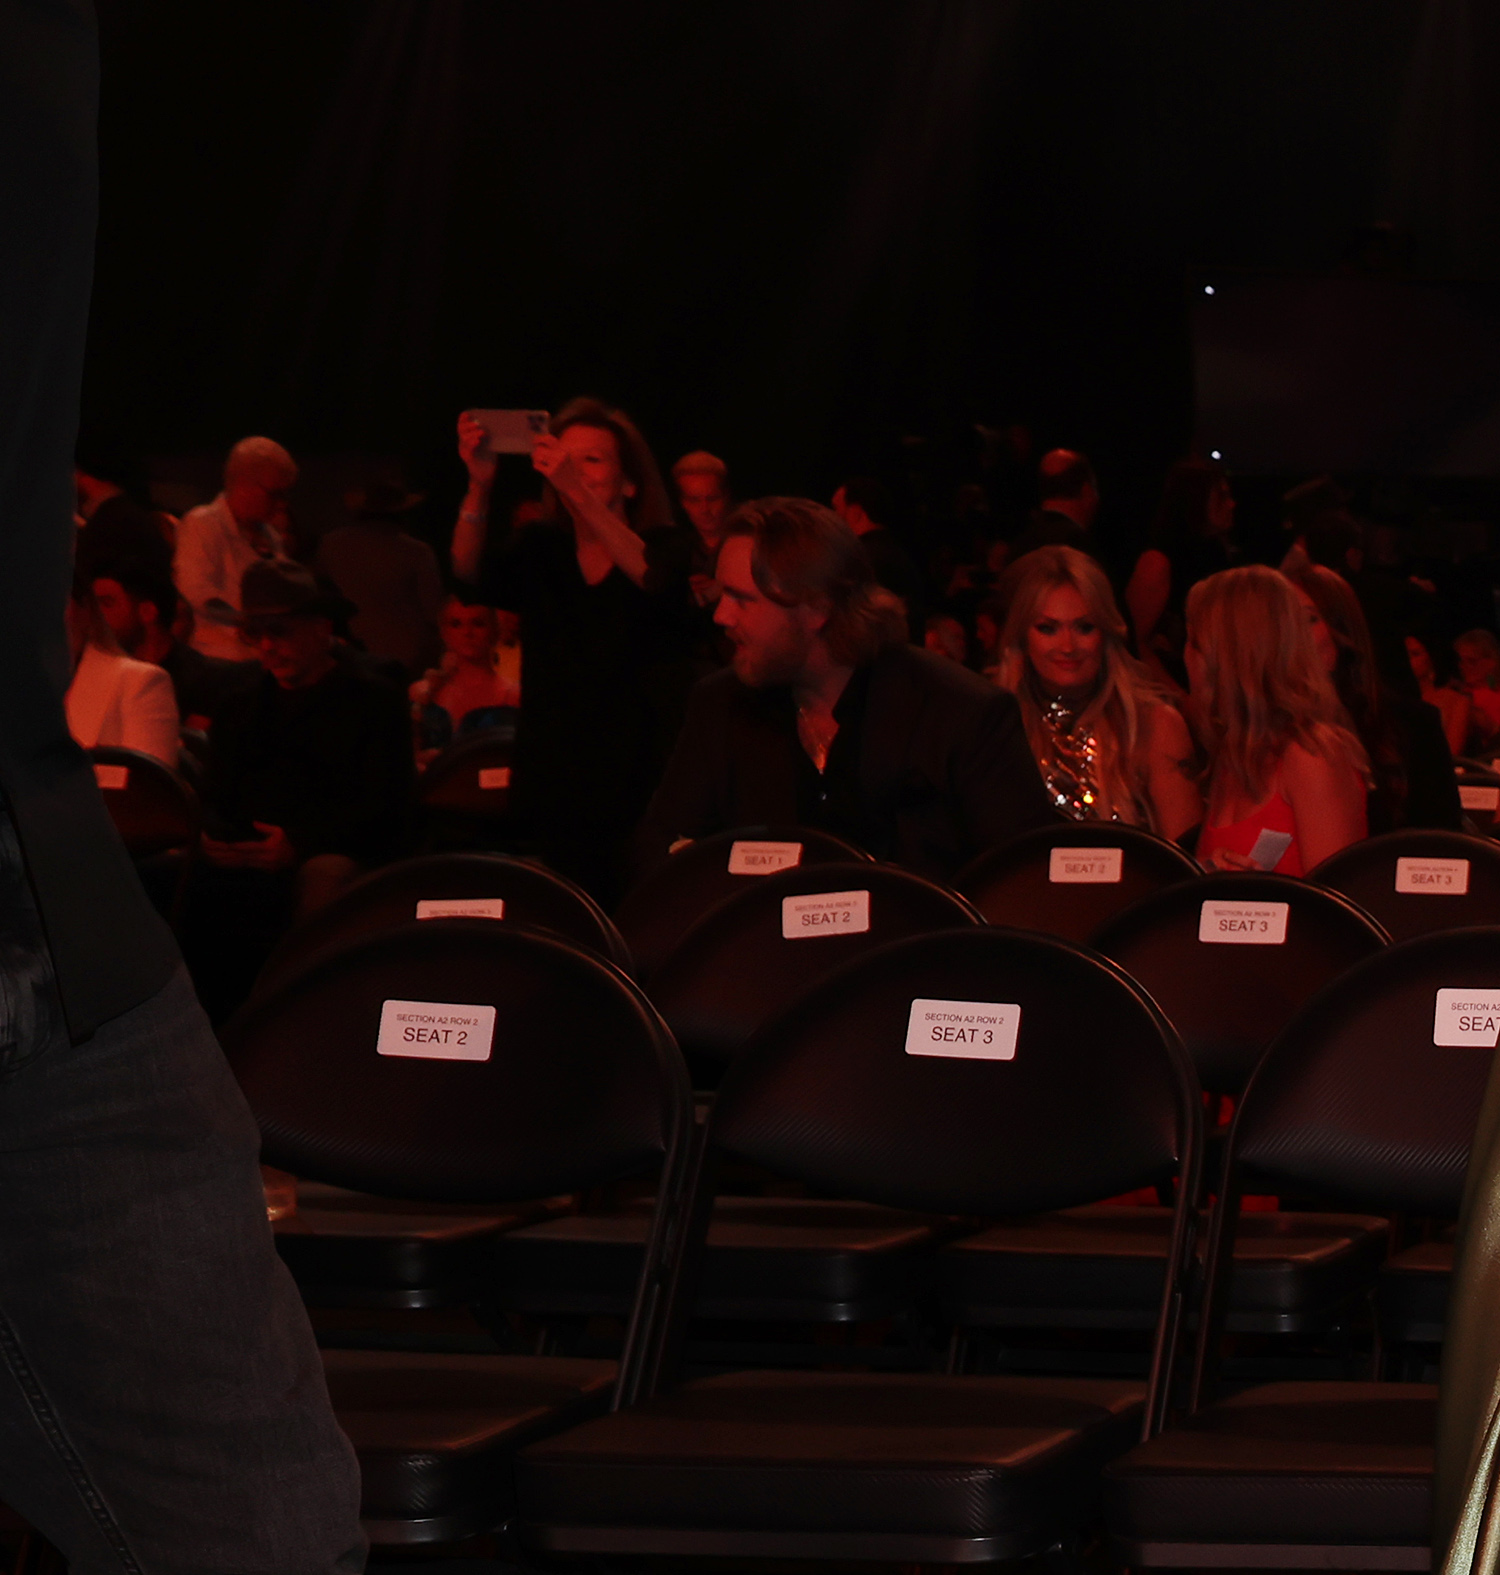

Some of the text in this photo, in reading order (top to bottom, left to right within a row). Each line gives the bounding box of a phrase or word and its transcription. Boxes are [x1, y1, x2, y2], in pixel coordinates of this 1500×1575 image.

[744, 855, 773, 866] SEAT
[1411, 873, 1442, 885] SEAT
[801, 911, 851, 926] SEAT 2
[1219, 919, 1268, 932] SEAT 3
[1451, 1002, 1489, 1011] SECTION
[397, 1013, 479, 1026] SECTION A2 ROW 2
[925, 1012, 1004, 1025] SECTION A2 ROW 2
[403, 1027, 468, 1045] SEAT 2
[931, 1026, 994, 1044] SEAT 3
